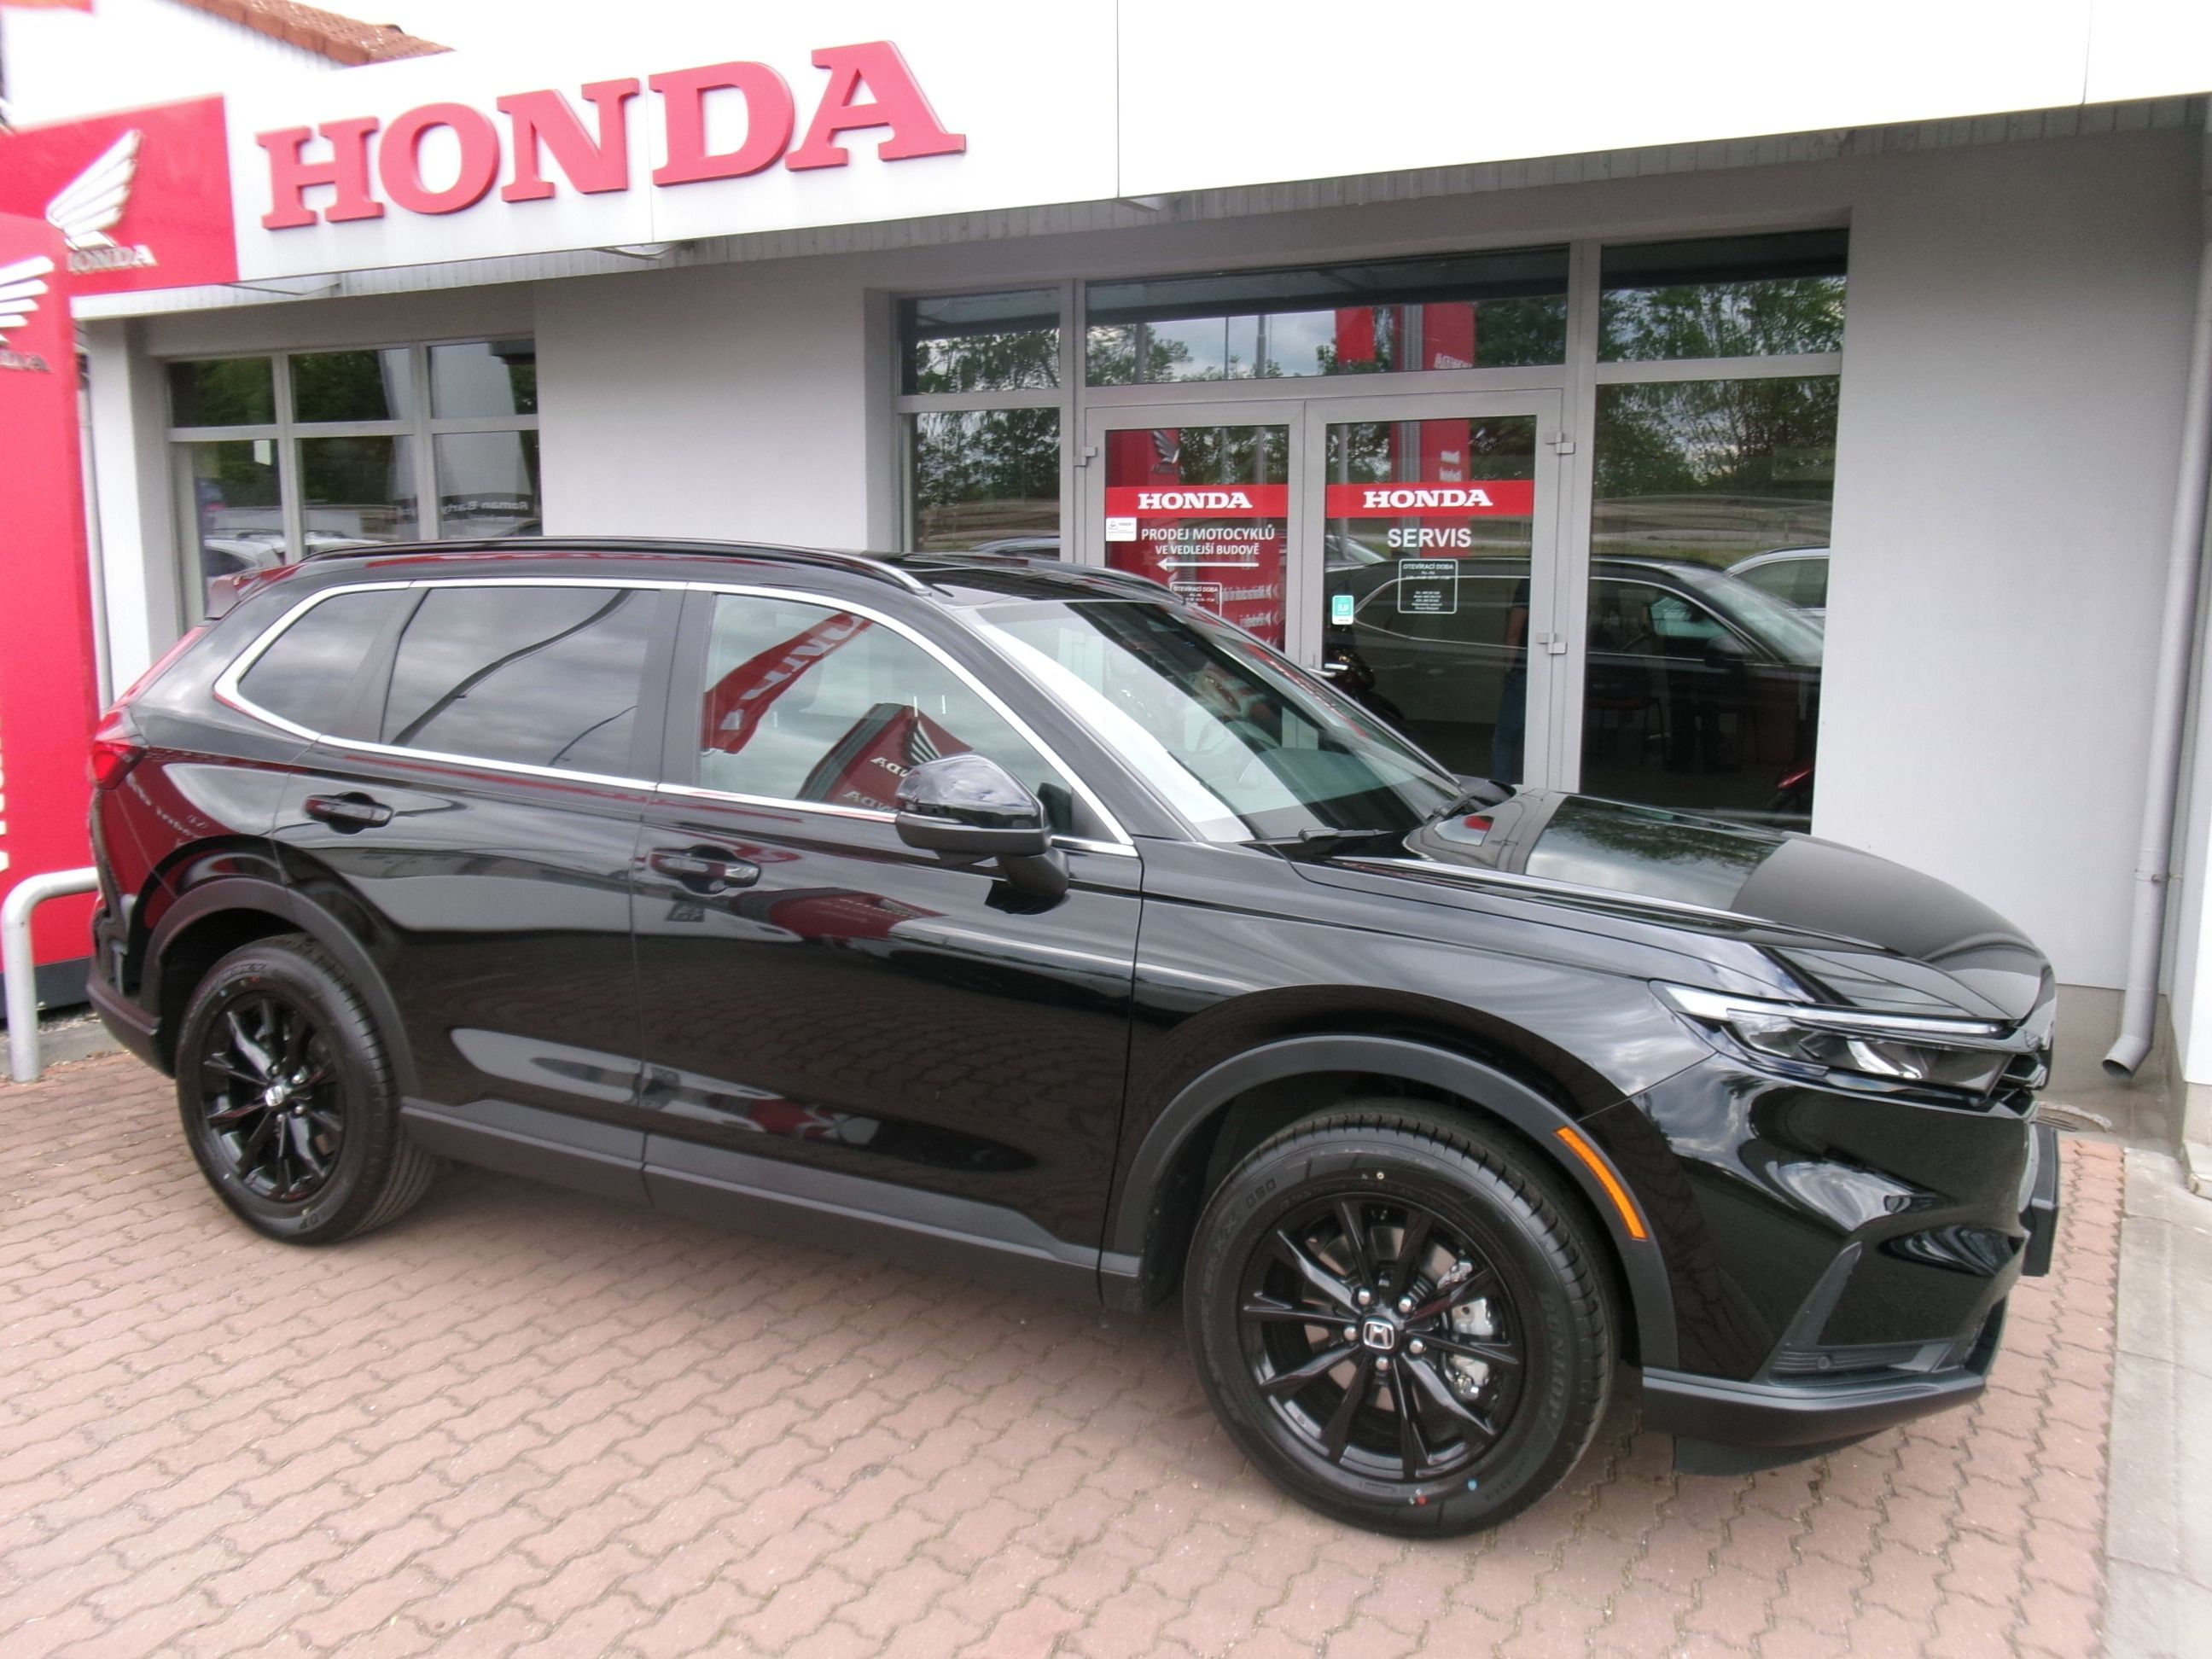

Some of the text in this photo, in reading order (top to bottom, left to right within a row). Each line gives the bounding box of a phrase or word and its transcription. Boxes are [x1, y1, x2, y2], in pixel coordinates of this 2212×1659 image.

[255, 39, 967, 230] HONDA
[1138, 492, 1254, 509] HONDA
[1363, 489, 1493, 509] HONDA
[1141, 527, 1190, 541] PRODEJ
[1192, 523, 1276, 541] MOTOCYKLŮ
[1387, 527, 1473, 548] SERVIS
[1155, 542, 1260, 556] VE VEDLEJŠÍ BUDOVĚ
